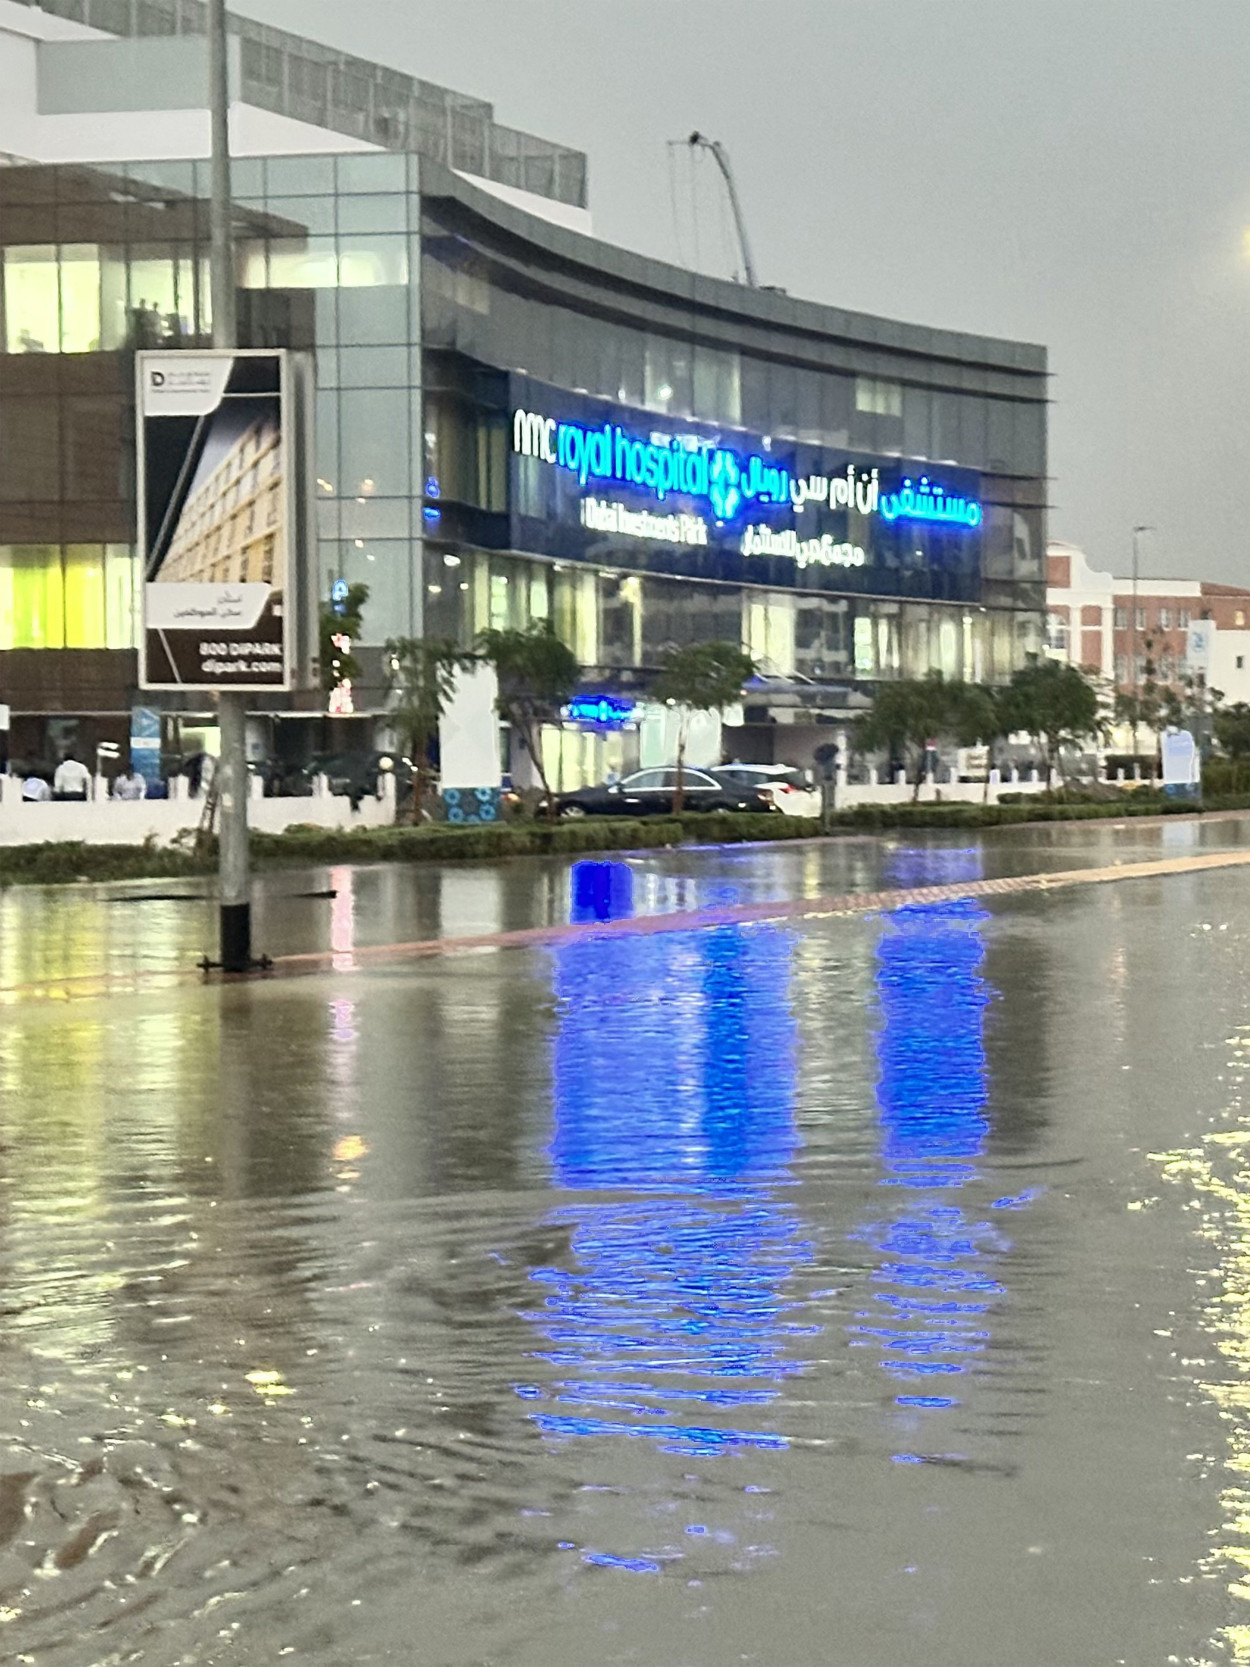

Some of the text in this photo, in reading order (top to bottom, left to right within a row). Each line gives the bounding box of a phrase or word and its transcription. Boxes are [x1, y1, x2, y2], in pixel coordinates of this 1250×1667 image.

[514, 408, 709, 500] nmc royal hospital
[881, 476, 982, 527] مستشفى
[199, 642, 228, 656] 800
